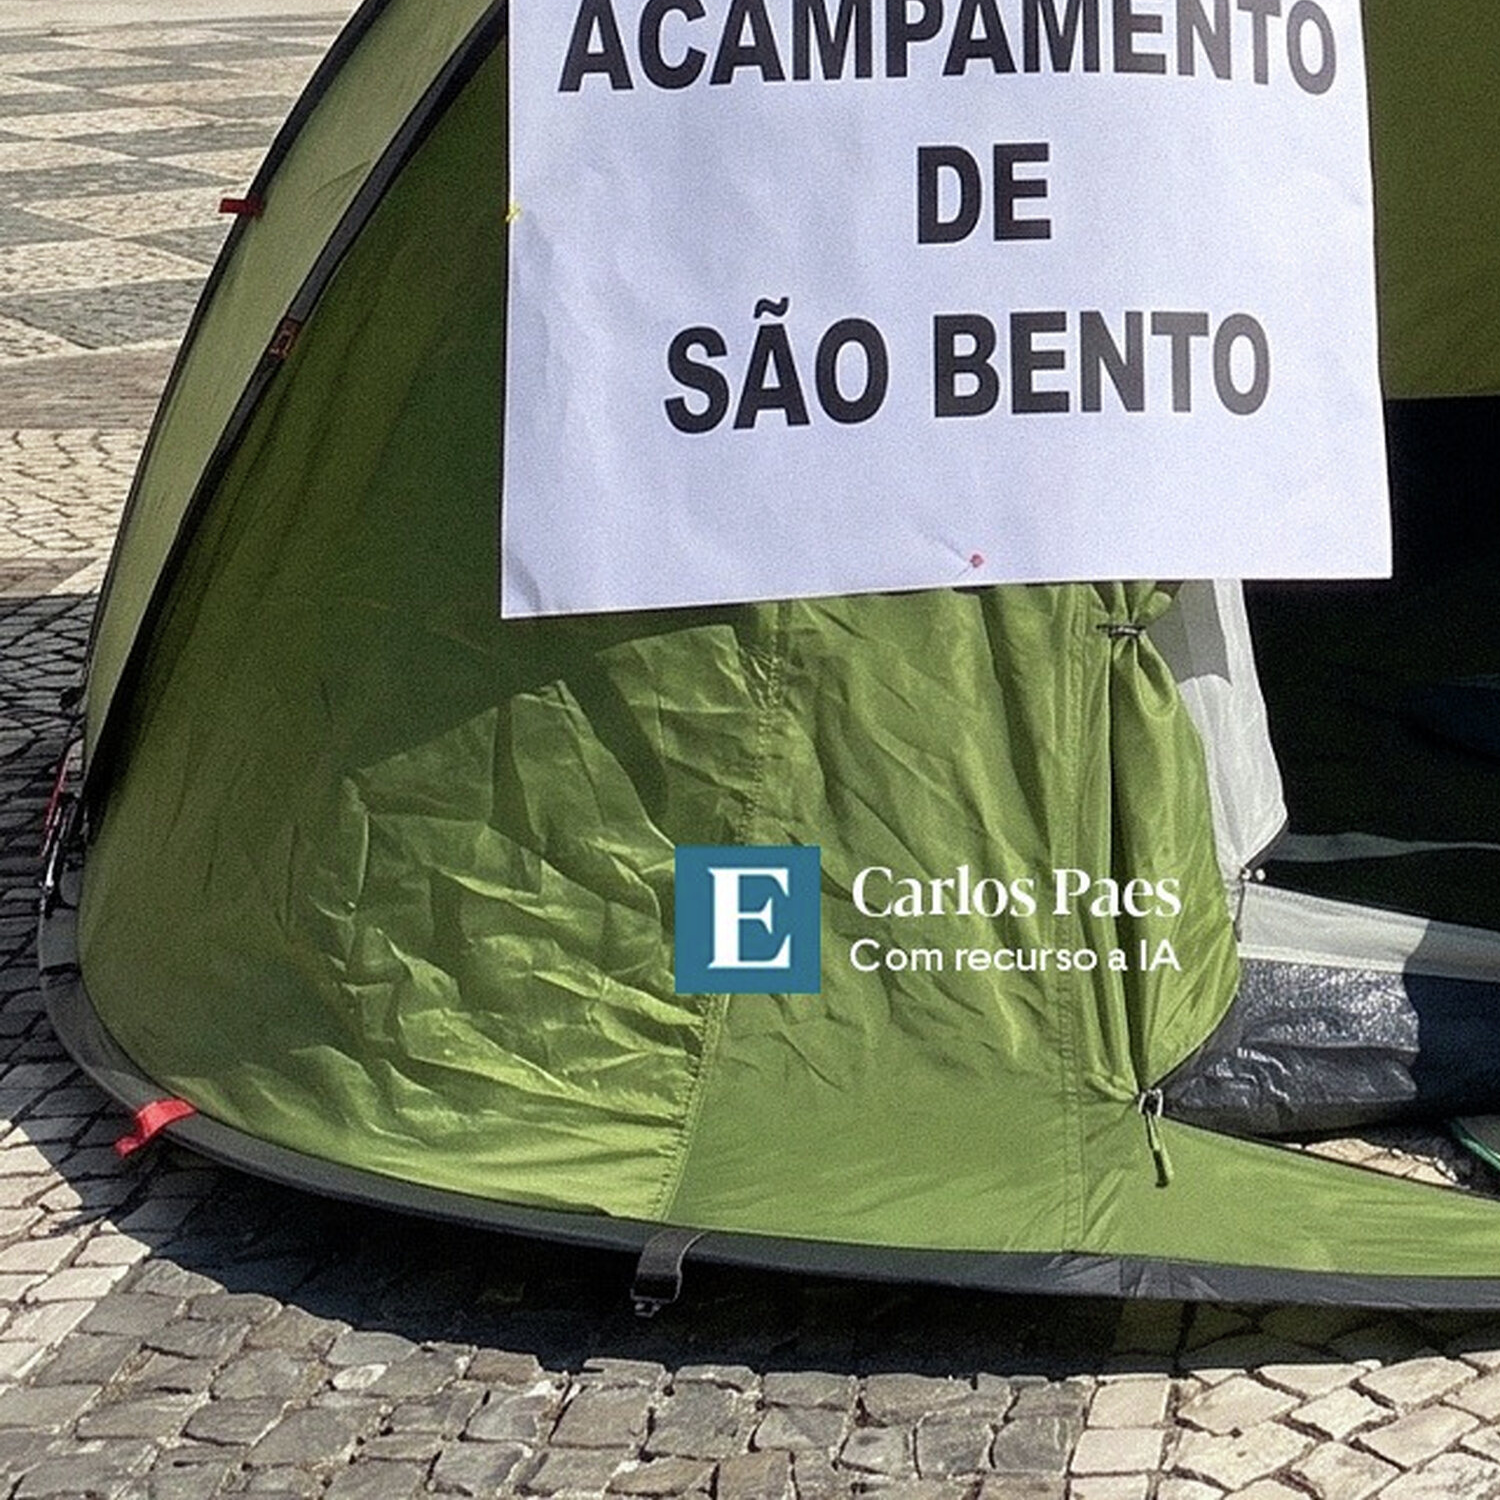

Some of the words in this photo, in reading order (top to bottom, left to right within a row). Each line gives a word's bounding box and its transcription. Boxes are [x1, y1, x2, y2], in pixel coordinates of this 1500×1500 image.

[916, 142, 1052, 245] DE
[662, 296, 890, 435] SÃO
[932, 310, 1270, 418] BENTO
